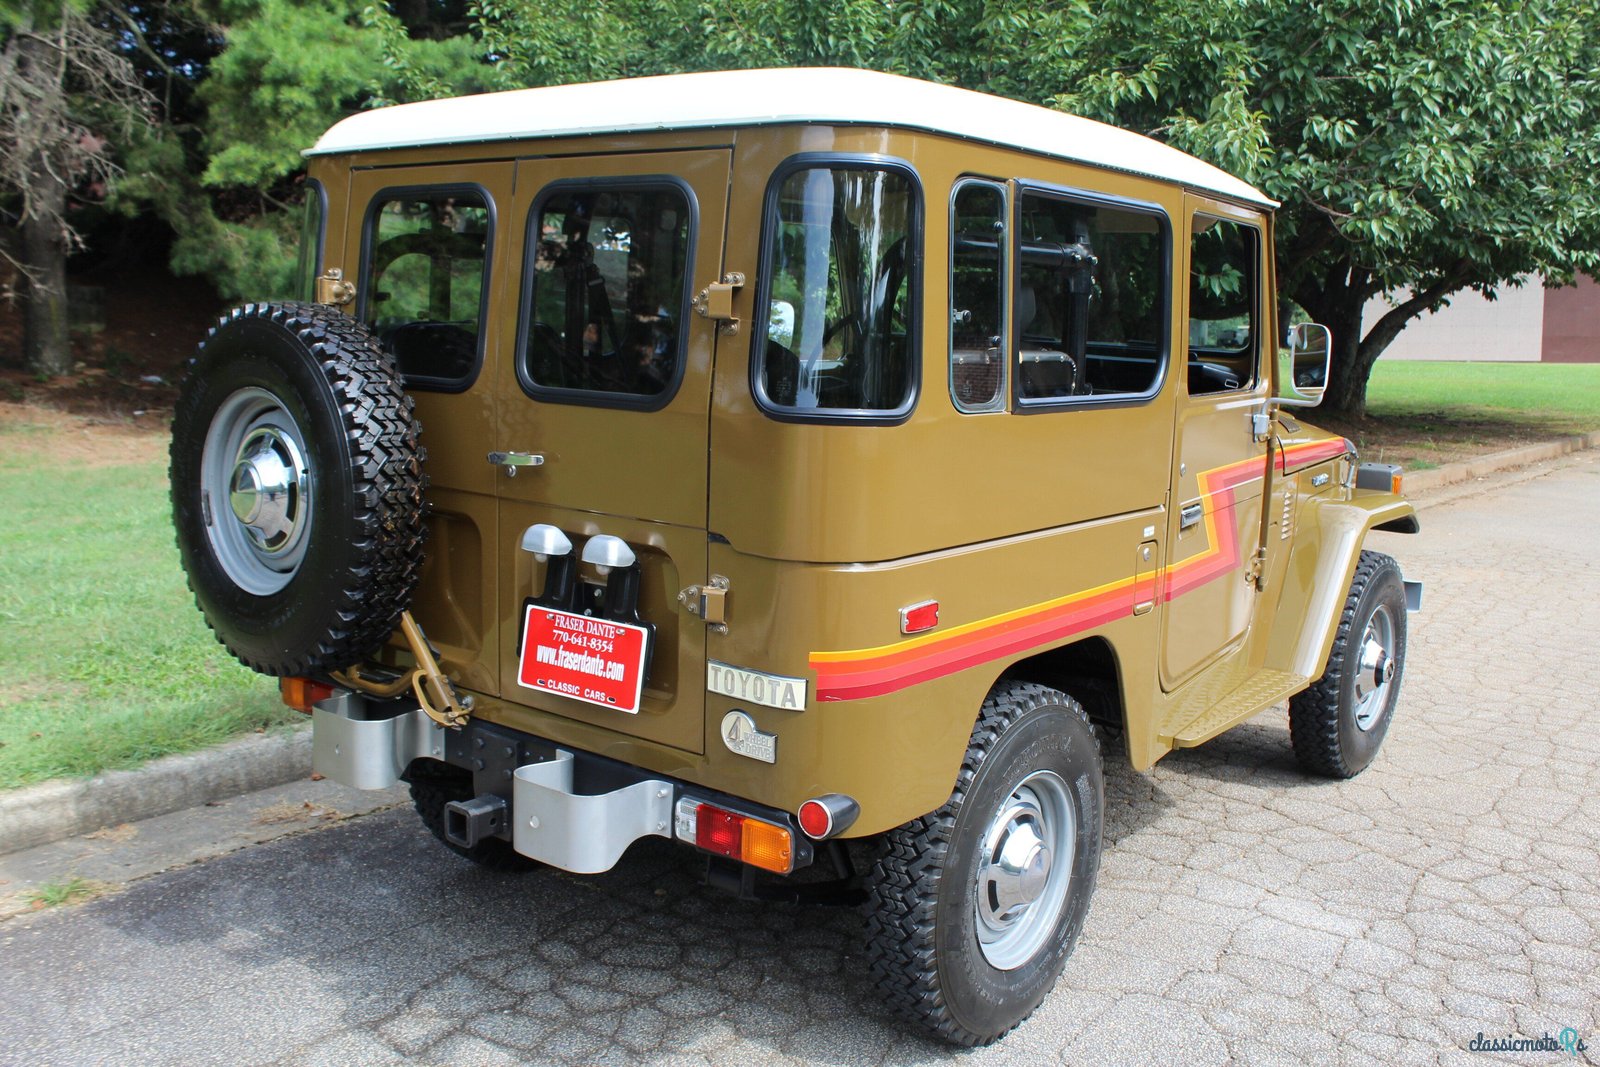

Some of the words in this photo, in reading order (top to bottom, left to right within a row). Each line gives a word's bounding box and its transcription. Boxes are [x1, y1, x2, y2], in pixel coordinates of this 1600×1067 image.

[554, 614, 585, 632] FRASER
[586, 622, 615, 638] DANTE
[552, 629, 613, 652] 770-641-8354
[536, 645, 625, 682] www.fraserdante.com
[547, 679, 580, 695] CLASSIC
[584, 688, 606, 702] CARS
[711, 665, 797, 708] TOYOTA
[727, 716, 744, 752] 4
[744, 731, 770, 748] WHEEL
[745, 743, 772, 759] DRIVE
